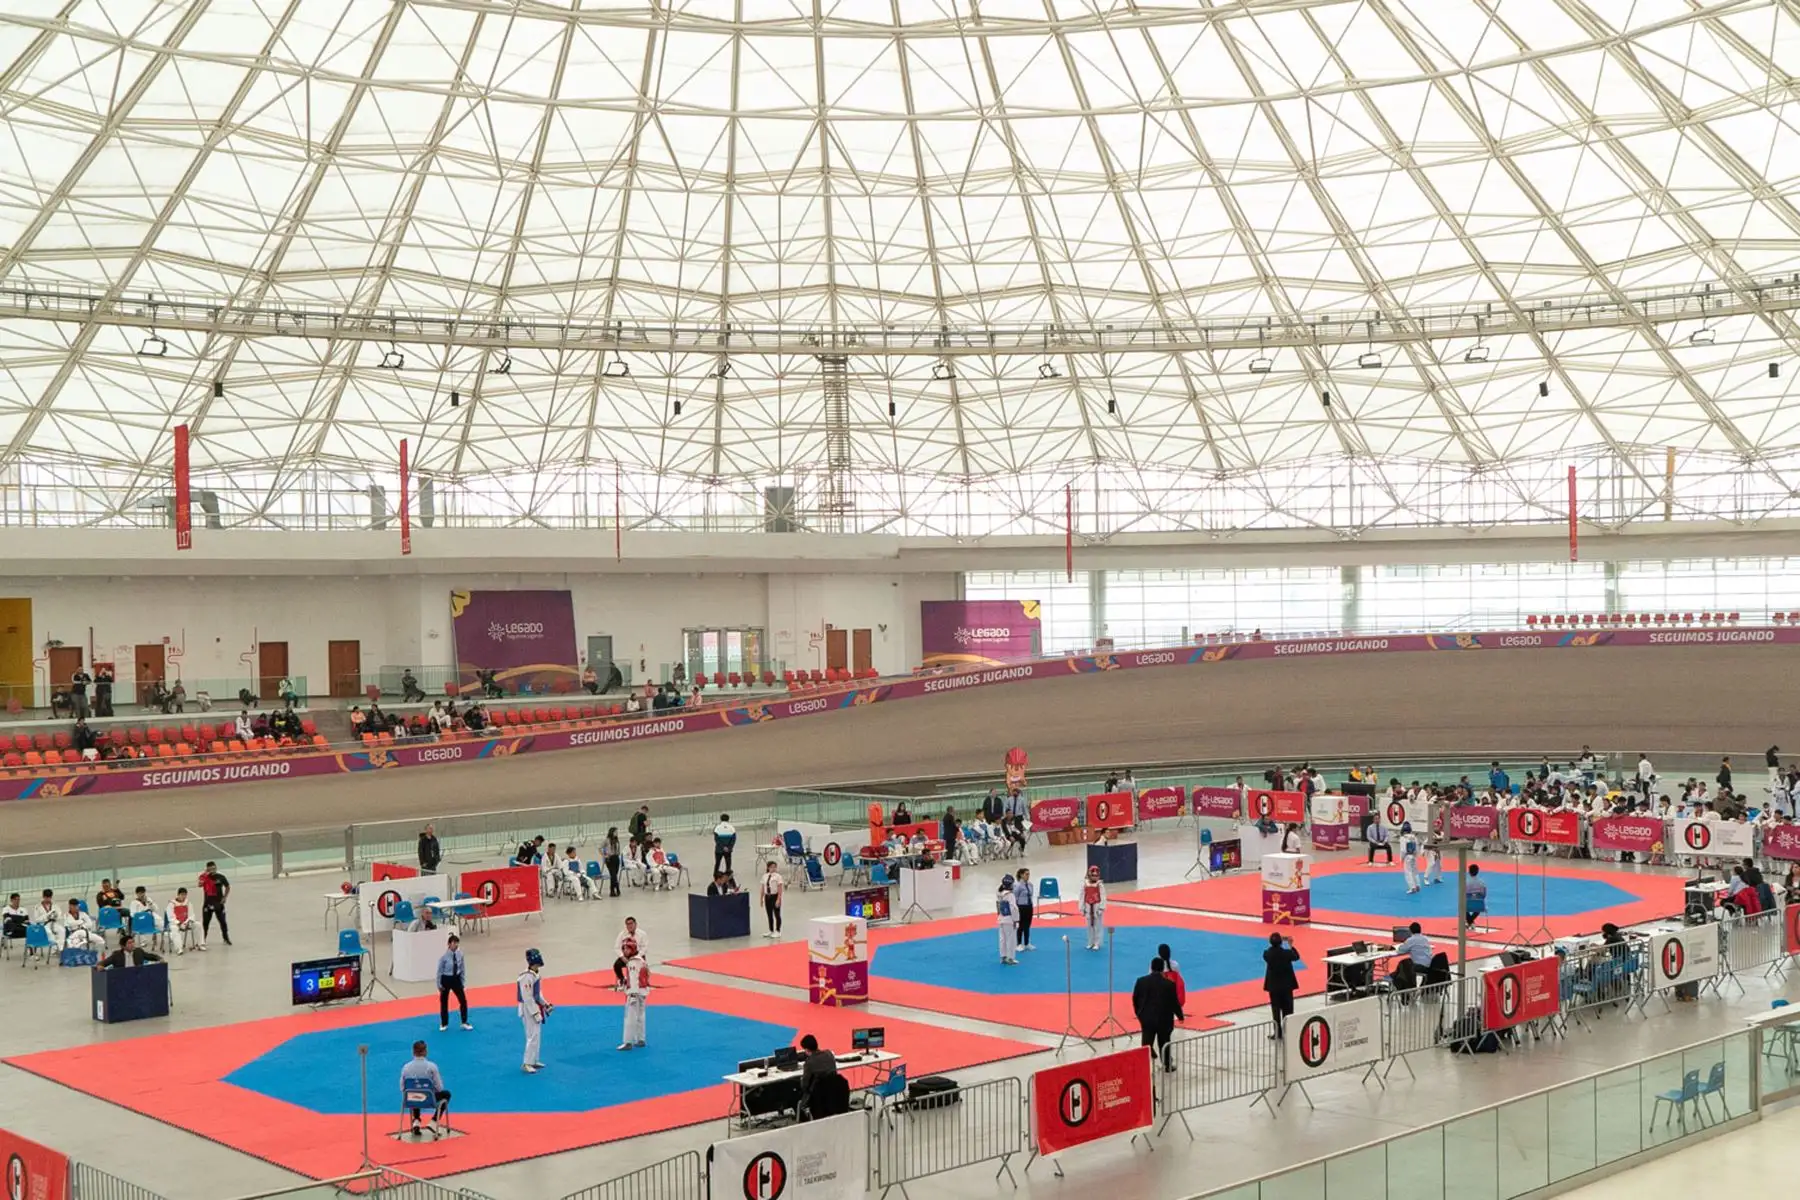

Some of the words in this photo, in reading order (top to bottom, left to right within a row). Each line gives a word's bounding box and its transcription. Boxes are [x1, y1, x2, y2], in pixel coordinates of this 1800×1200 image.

[1649, 631, 1714, 643] SEGUIMOS
[1715, 630, 1775, 641] JUGANDO
[1274, 642, 1333, 655] SEGUIMOS
[1334, 639, 1389, 652] JUGANDO
[924, 674, 981, 692] SEGUIMOS
[982, 665, 1032, 683] JUGANDO
[570, 727, 630, 745] SEGUIMOS
[631, 719, 684, 737] JUGANDO
[143, 767, 221, 787] SEGUIMOS
[223, 762, 290, 780] JUGANDO
[945, 871, 951, 879] 2
[875, 901, 881, 912] 8
[306, 978, 314, 991] 3
[338, 973, 348, 987] 4
